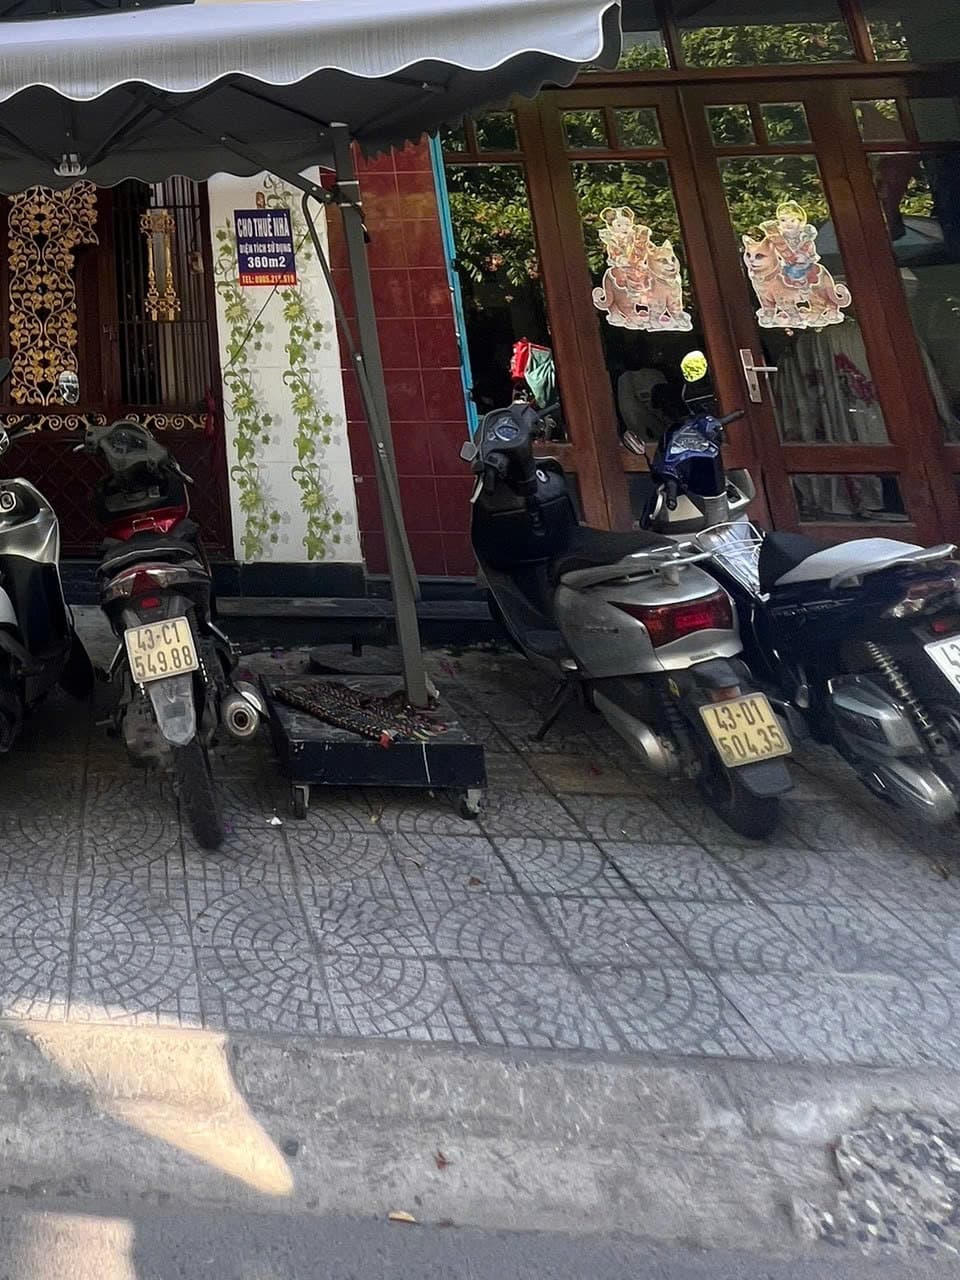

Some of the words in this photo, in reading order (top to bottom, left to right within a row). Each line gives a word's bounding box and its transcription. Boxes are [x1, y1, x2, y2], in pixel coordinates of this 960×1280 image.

[237, 218, 253, 237] CHO
[253, 214, 273, 237] THUÊ
[273, 213, 290, 236] NHÀ
[247, 256, 286, 268] 360m2
[137, 622, 180, 651] 43-C1
[134, 645, 193, 678] 549.88
[718, 724, 785, 760] 504.35
